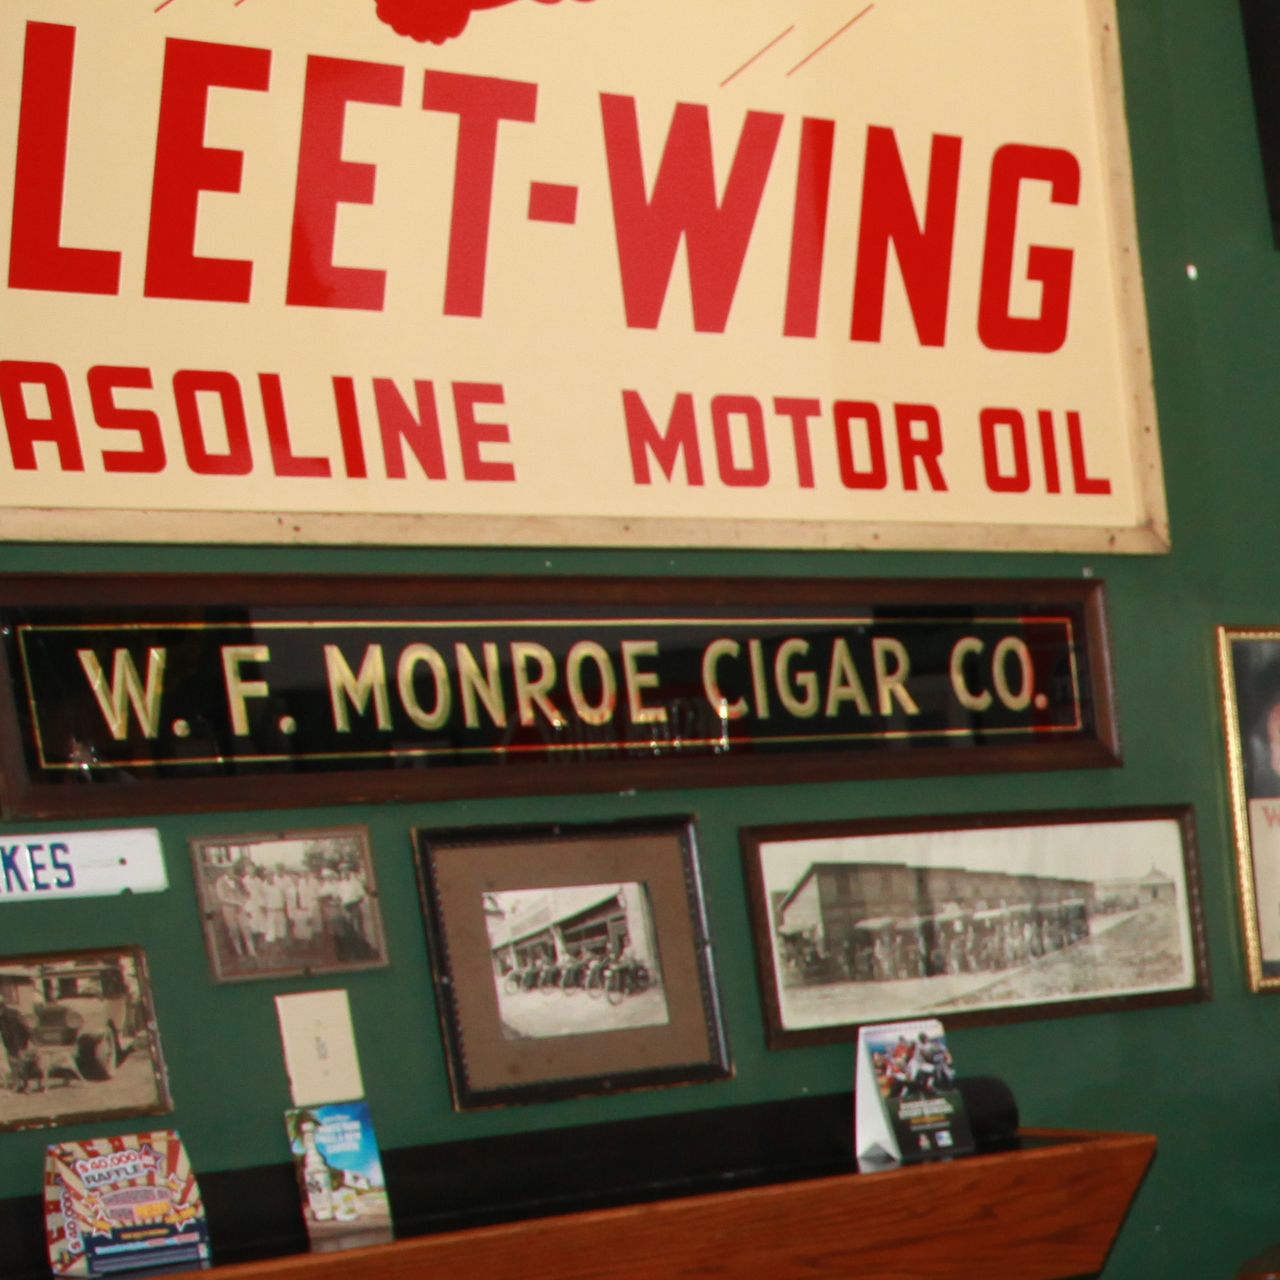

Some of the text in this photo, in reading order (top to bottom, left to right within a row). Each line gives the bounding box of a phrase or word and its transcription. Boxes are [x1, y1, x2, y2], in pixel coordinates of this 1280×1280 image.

[0, 359, 1113, 496] ASOLINE MOTOR OIL
[78, 635, 1050, 741] W. F. MONROE CIGAR CO.
[0, 842, 77, 893] KES
